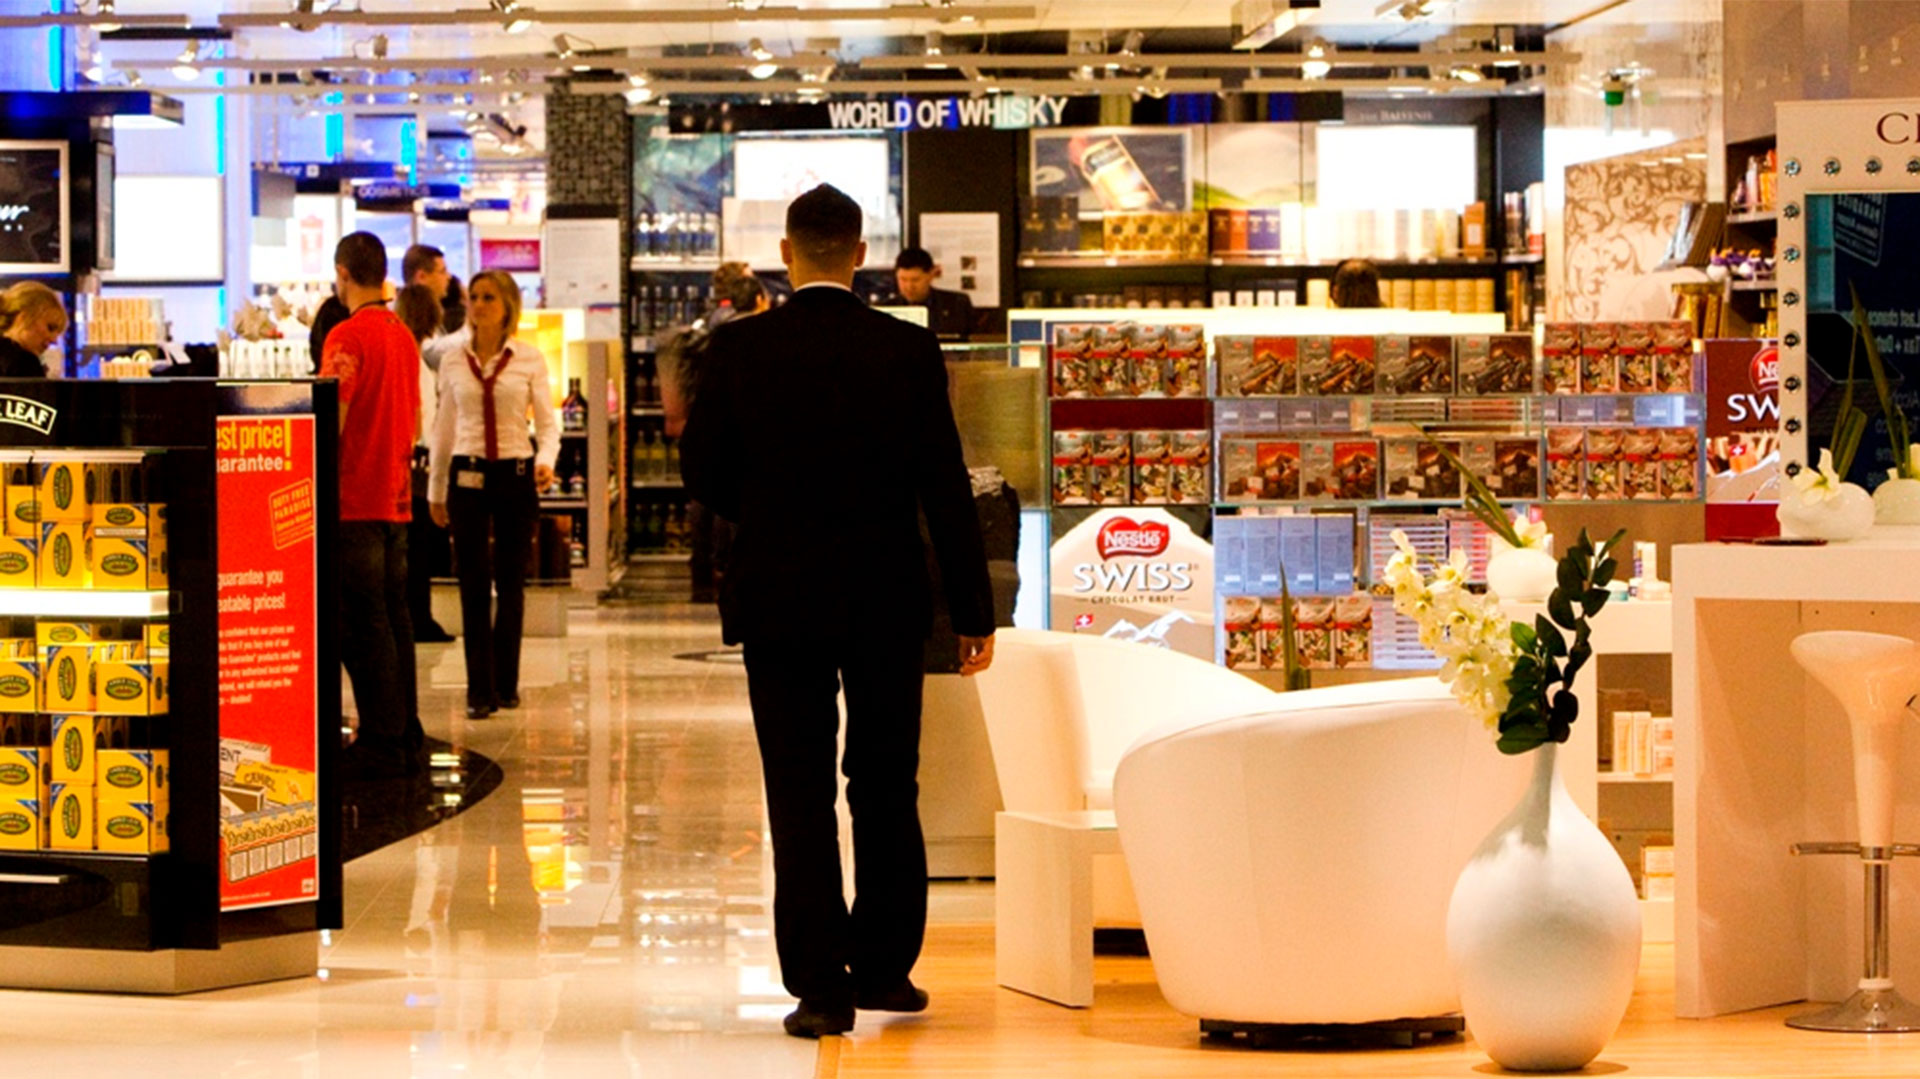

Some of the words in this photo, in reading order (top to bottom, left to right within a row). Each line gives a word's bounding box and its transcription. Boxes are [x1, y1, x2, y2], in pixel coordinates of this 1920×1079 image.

[828, 102, 913, 128] WORLD
[916, 101, 950, 128] OF
[957, 96, 1067, 127] WHISKY
[1876, 112, 1920, 144] C
[6, 400, 49, 426] LEAF
[1727, 393, 1779, 421] SW
[217, 453, 284, 473] arantee
[1073, 563, 1193, 593] SWISS
[219, 747, 241, 761] ENT
